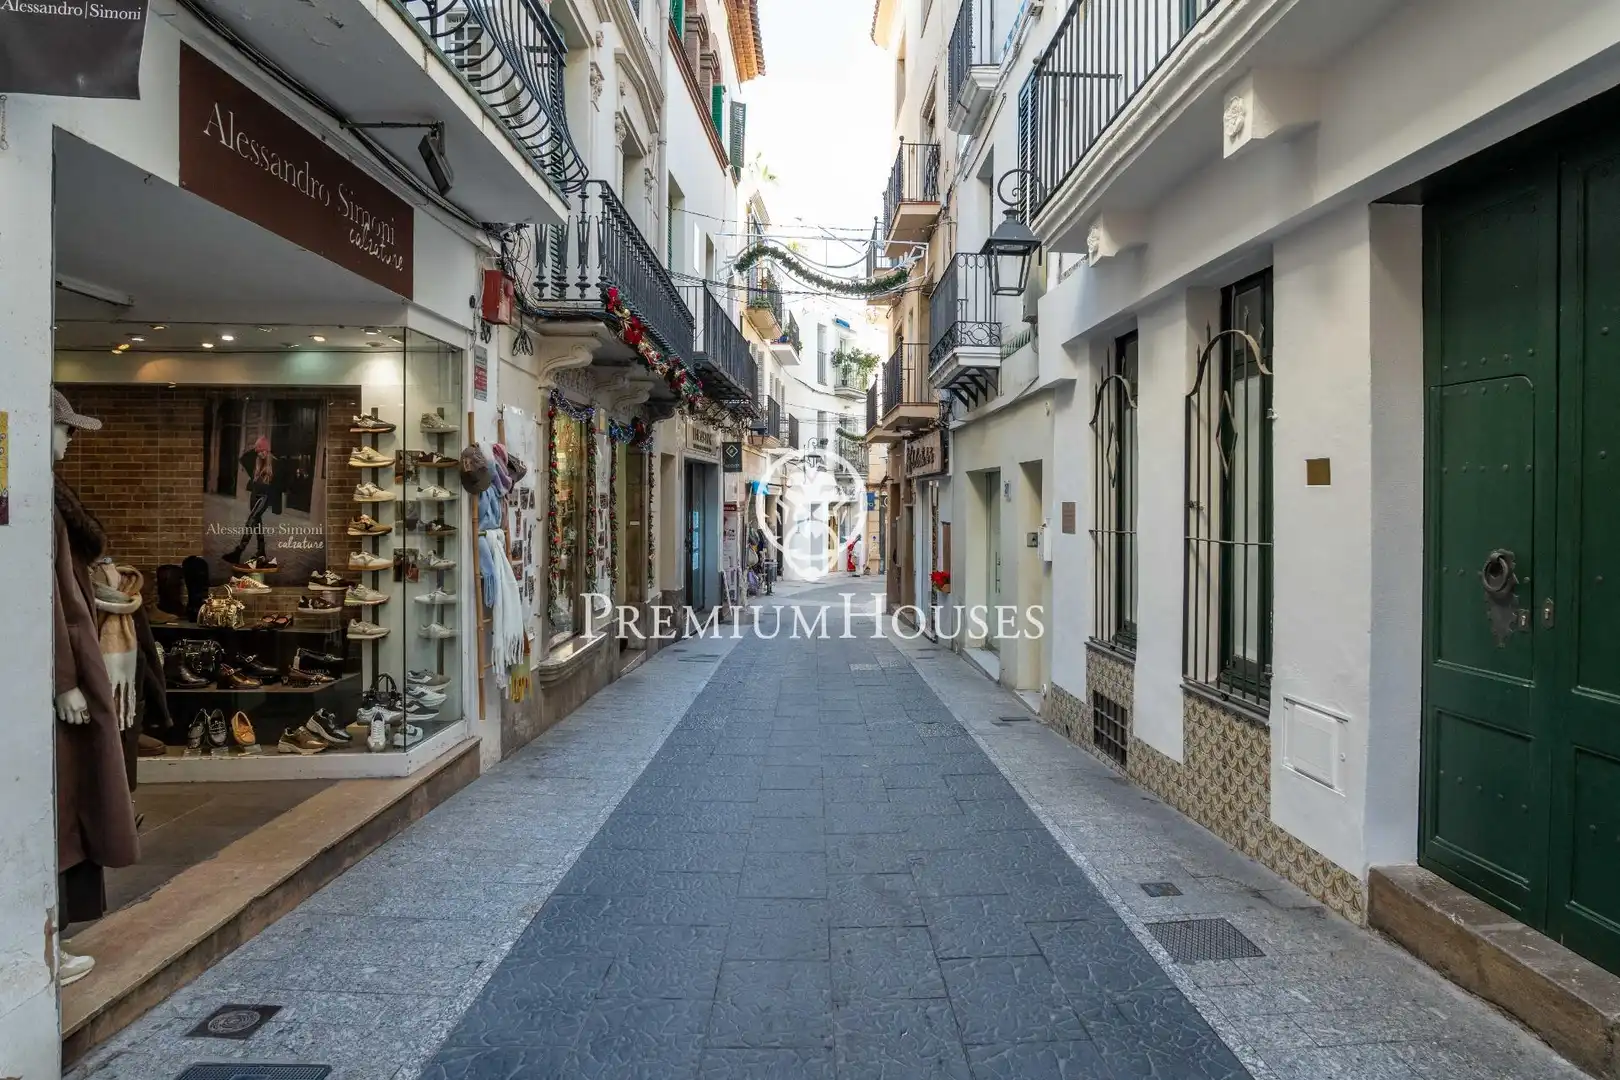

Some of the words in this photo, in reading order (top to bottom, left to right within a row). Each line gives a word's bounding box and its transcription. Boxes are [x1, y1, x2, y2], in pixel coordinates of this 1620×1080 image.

[0, 0, 83, 16] Alessandro
[89, 3, 142, 20] Simoni
[203, 102, 330, 206] Alessandro
[337, 183, 396, 246] Simoni
[205, 523, 275, 535] Alessandro
[278, 523, 323, 535] Simoni
[277, 536, 324, 550] calzature
